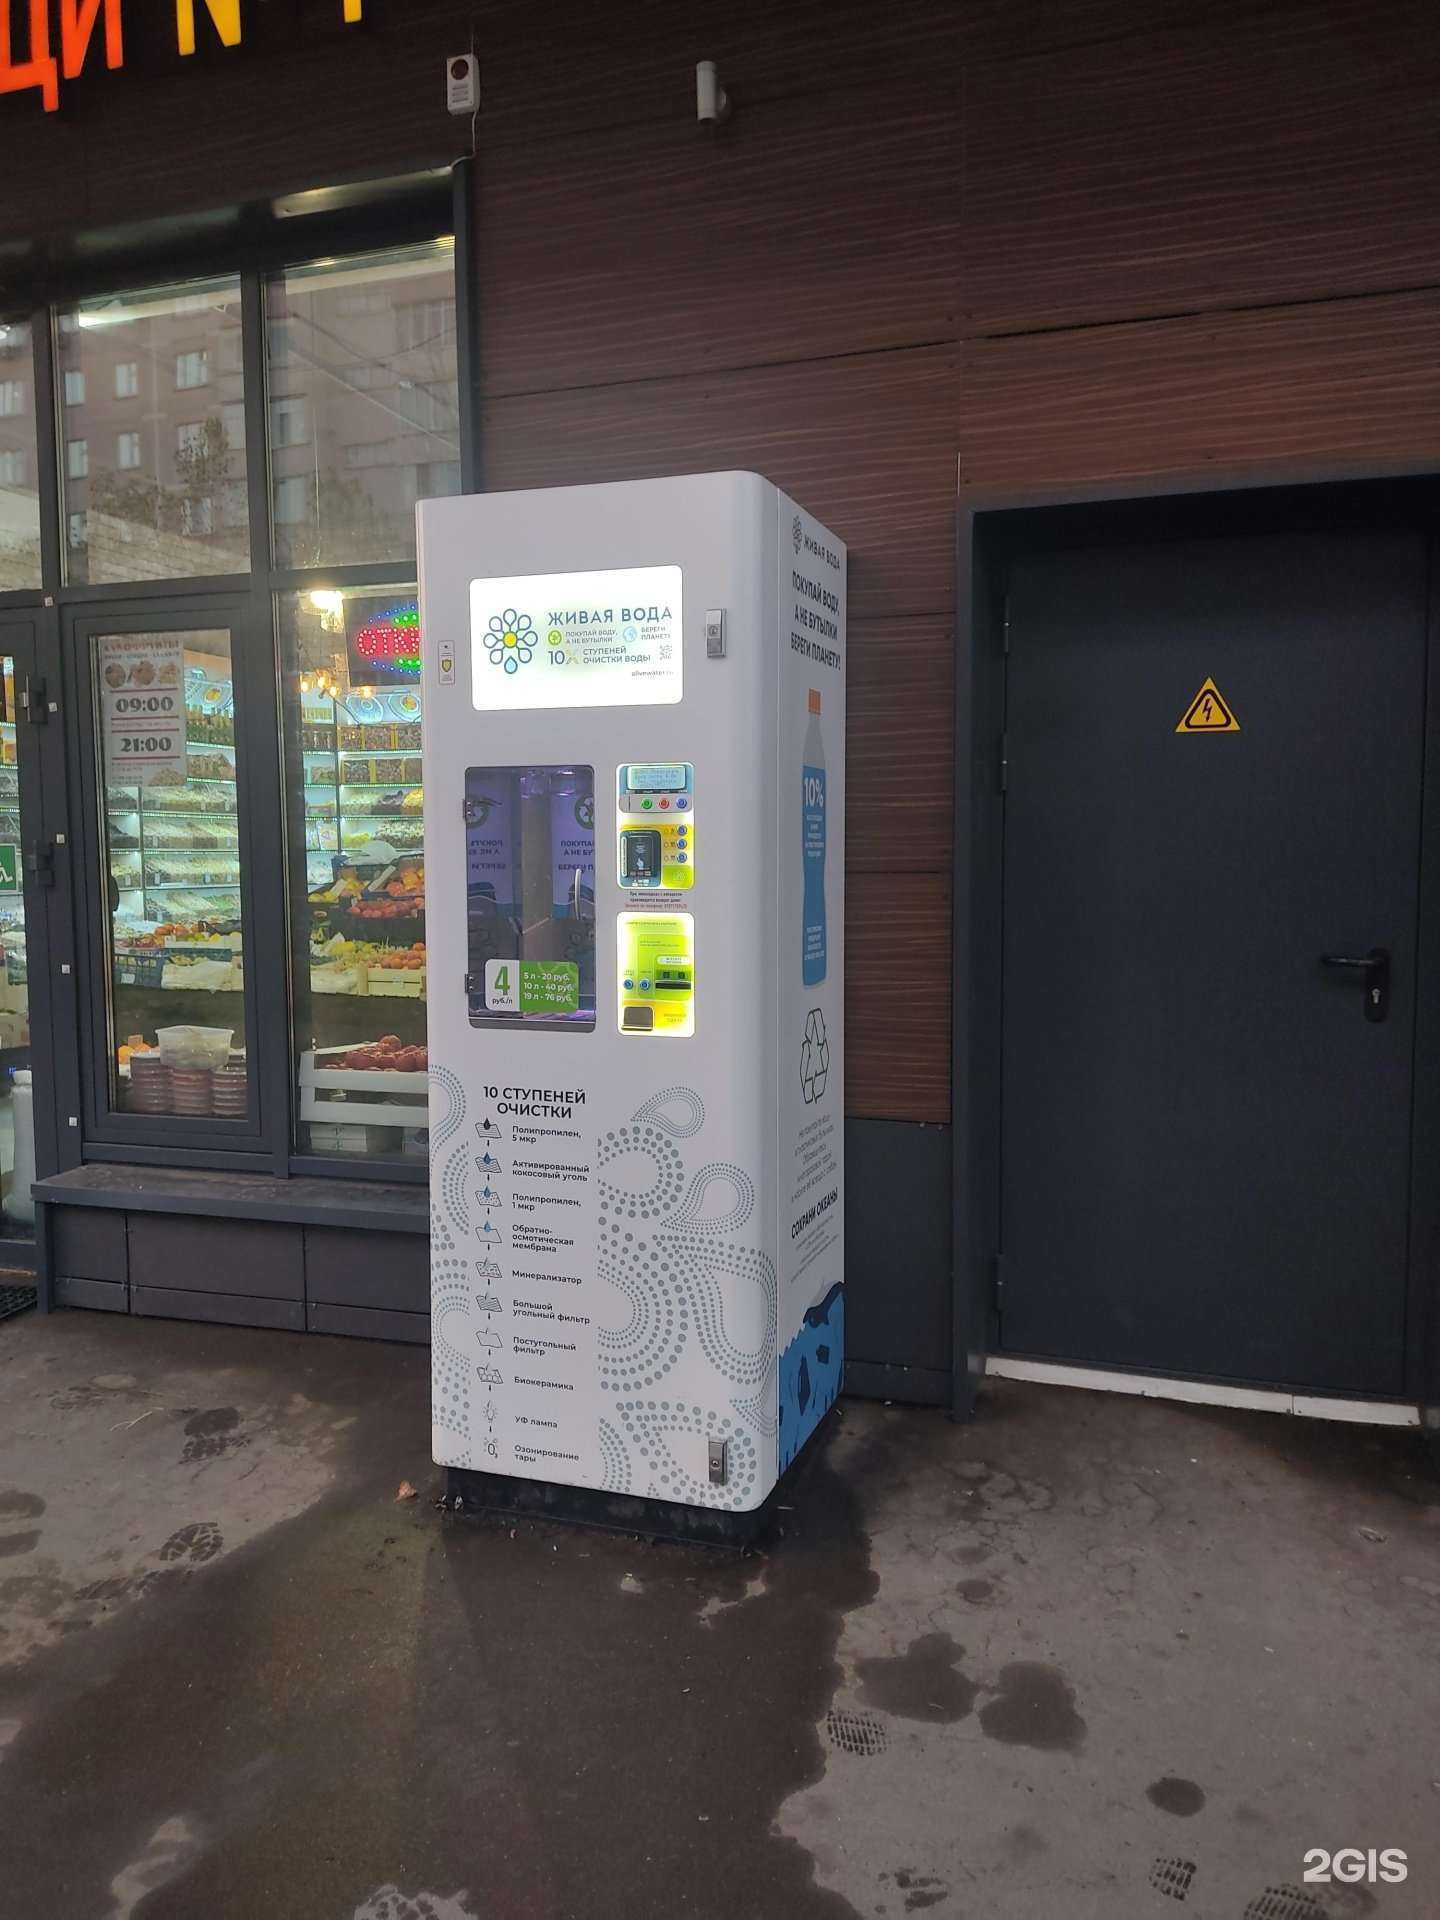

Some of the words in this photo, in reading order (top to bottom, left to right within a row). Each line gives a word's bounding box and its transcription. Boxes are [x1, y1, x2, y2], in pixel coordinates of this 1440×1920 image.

[803, 534, 825, 557] ЖИВАЯ
[826, 549, 840, 569] ВОДА
[792, 569, 822, 604] ПОКУПАЙ
[548, 609, 613, 626] ЖИВАЯ
[621, 606, 672, 623] ВОДА
[795, 604, 799, 621] А
[800, 605, 808, 627] НЕ
[808, 611, 837, 640] БУТЫЛКИ
[565, 629, 597, 637] ПОКУПАЙ
[548, 650, 566, 665] 10
[583, 646, 627, 656] СТУПЕНЕЙ
[791, 631, 811, 657] БЕРЕГИ
[811, 642, 841, 670] ПЛАНЕТУ!
[583, 655, 623, 664] ОЧИСТКИ
[625, 654, 651, 663] ВОДЫ
[115, 696, 174, 713] 09:00
[120, 736, 172, 752] 21:00
[803, 776, 824, 808] 10%
[494, 965, 511, 995] 4
[557, 983, 575, 992] руб.
[523, 992, 532, 1000] 19
[544, 993, 555, 1001] 76
[555, 993, 572, 1003] руб.
[483, 1086, 498, 1098] 10
[502, 1087, 586, 1105] СТУПЕНЕЙ
[496, 1102, 572, 1119] ОЧИСТКИ
[512, 1125, 582, 1139] Полипропилен,
[512, 1134, 518, 1142] 5
[519, 1136, 537, 1144] мкр
[512, 1160, 590, 1173] Активированный
[512, 1169, 561, 1179] кокосовый
[562, 1173, 588, 1182] уголь
[512, 1193, 582, 1208] Полипропилен,
[518, 1203, 535, 1211] мкр
[791, 1206, 816, 1239] СОХРАНИ
[816, 1187, 838, 1215] ОКЕАНЫ
[512, 1224, 553, 1235] Обратно-
[512, 1234, 574, 1246] осмотическая
[512, 1243, 557, 1252] мембрана
[512, 1270, 582, 1285] Минерализатор
[513, 1299, 553, 1311] Большой
[513, 1309, 555, 1320] угольный
[557, 1313, 590, 1325] фильтр
[513, 1336, 577, 1351] Постугольный
[513, 1345, 545, 1356] фильтр
[514, 1376, 574, 1391] Биокерамика
[514, 1415, 529, 1424] УФ
[530, 1419, 558, 1428] лампа
[514, 1444, 580, 1461] Озонирование
[514, 1454, 537, 1462] тары
